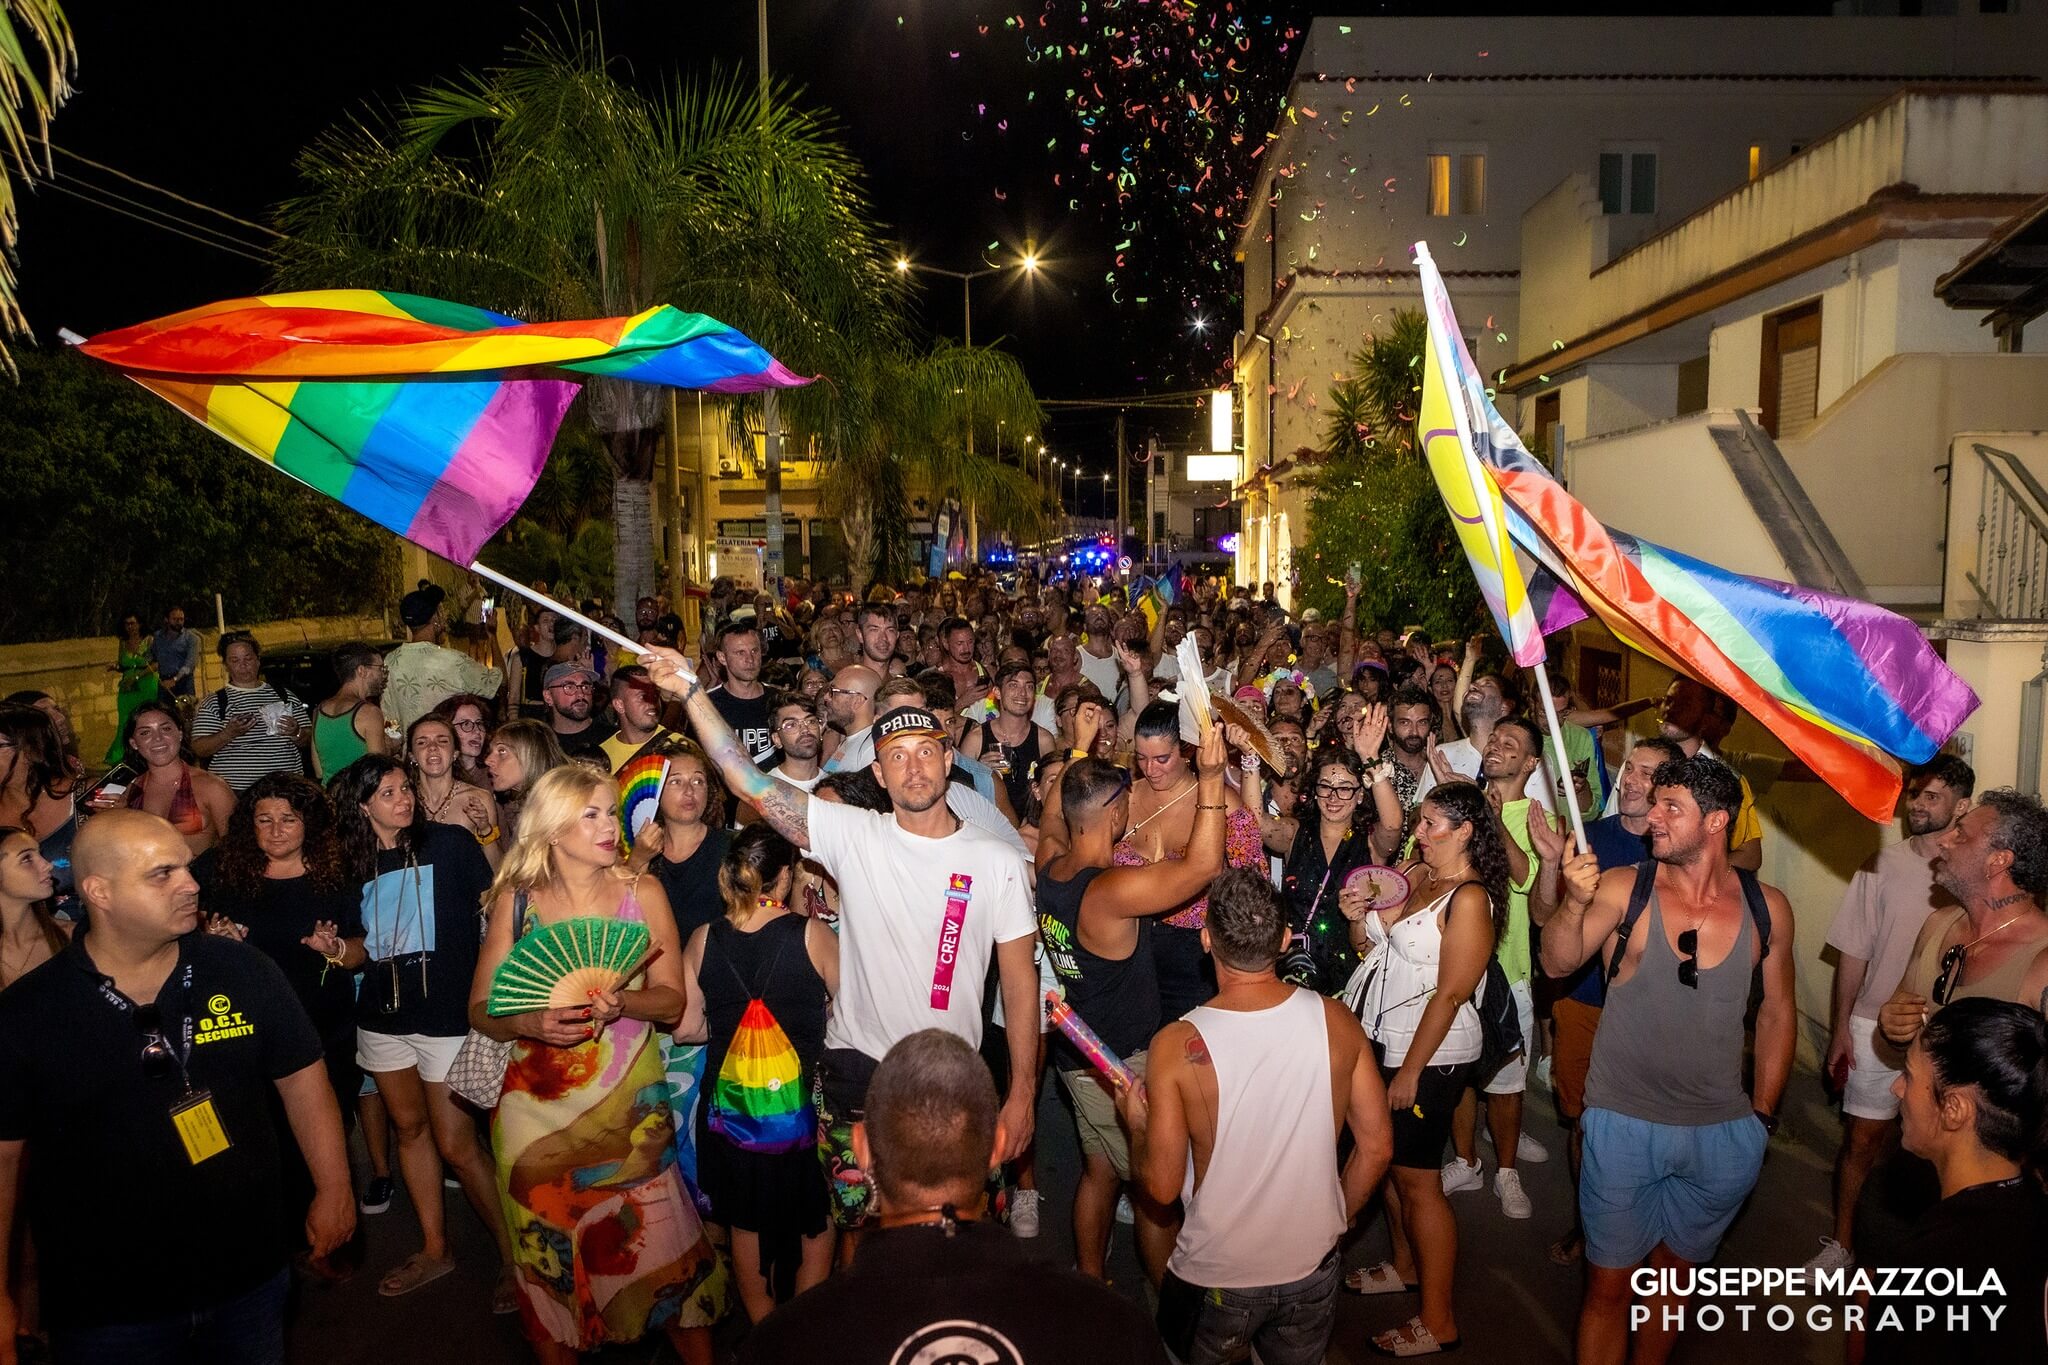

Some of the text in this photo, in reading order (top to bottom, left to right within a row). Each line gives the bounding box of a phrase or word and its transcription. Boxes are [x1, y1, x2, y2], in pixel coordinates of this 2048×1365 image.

[717, 539, 751, 547] GELATERIA
[880, 713, 934, 736] PRIDE
[940, 918, 960, 965] CREW
[933, 983, 950, 992] 2024
[200, 1012, 247, 1031] O.C.T.
[195, 1024, 254, 1044] SECURITY
